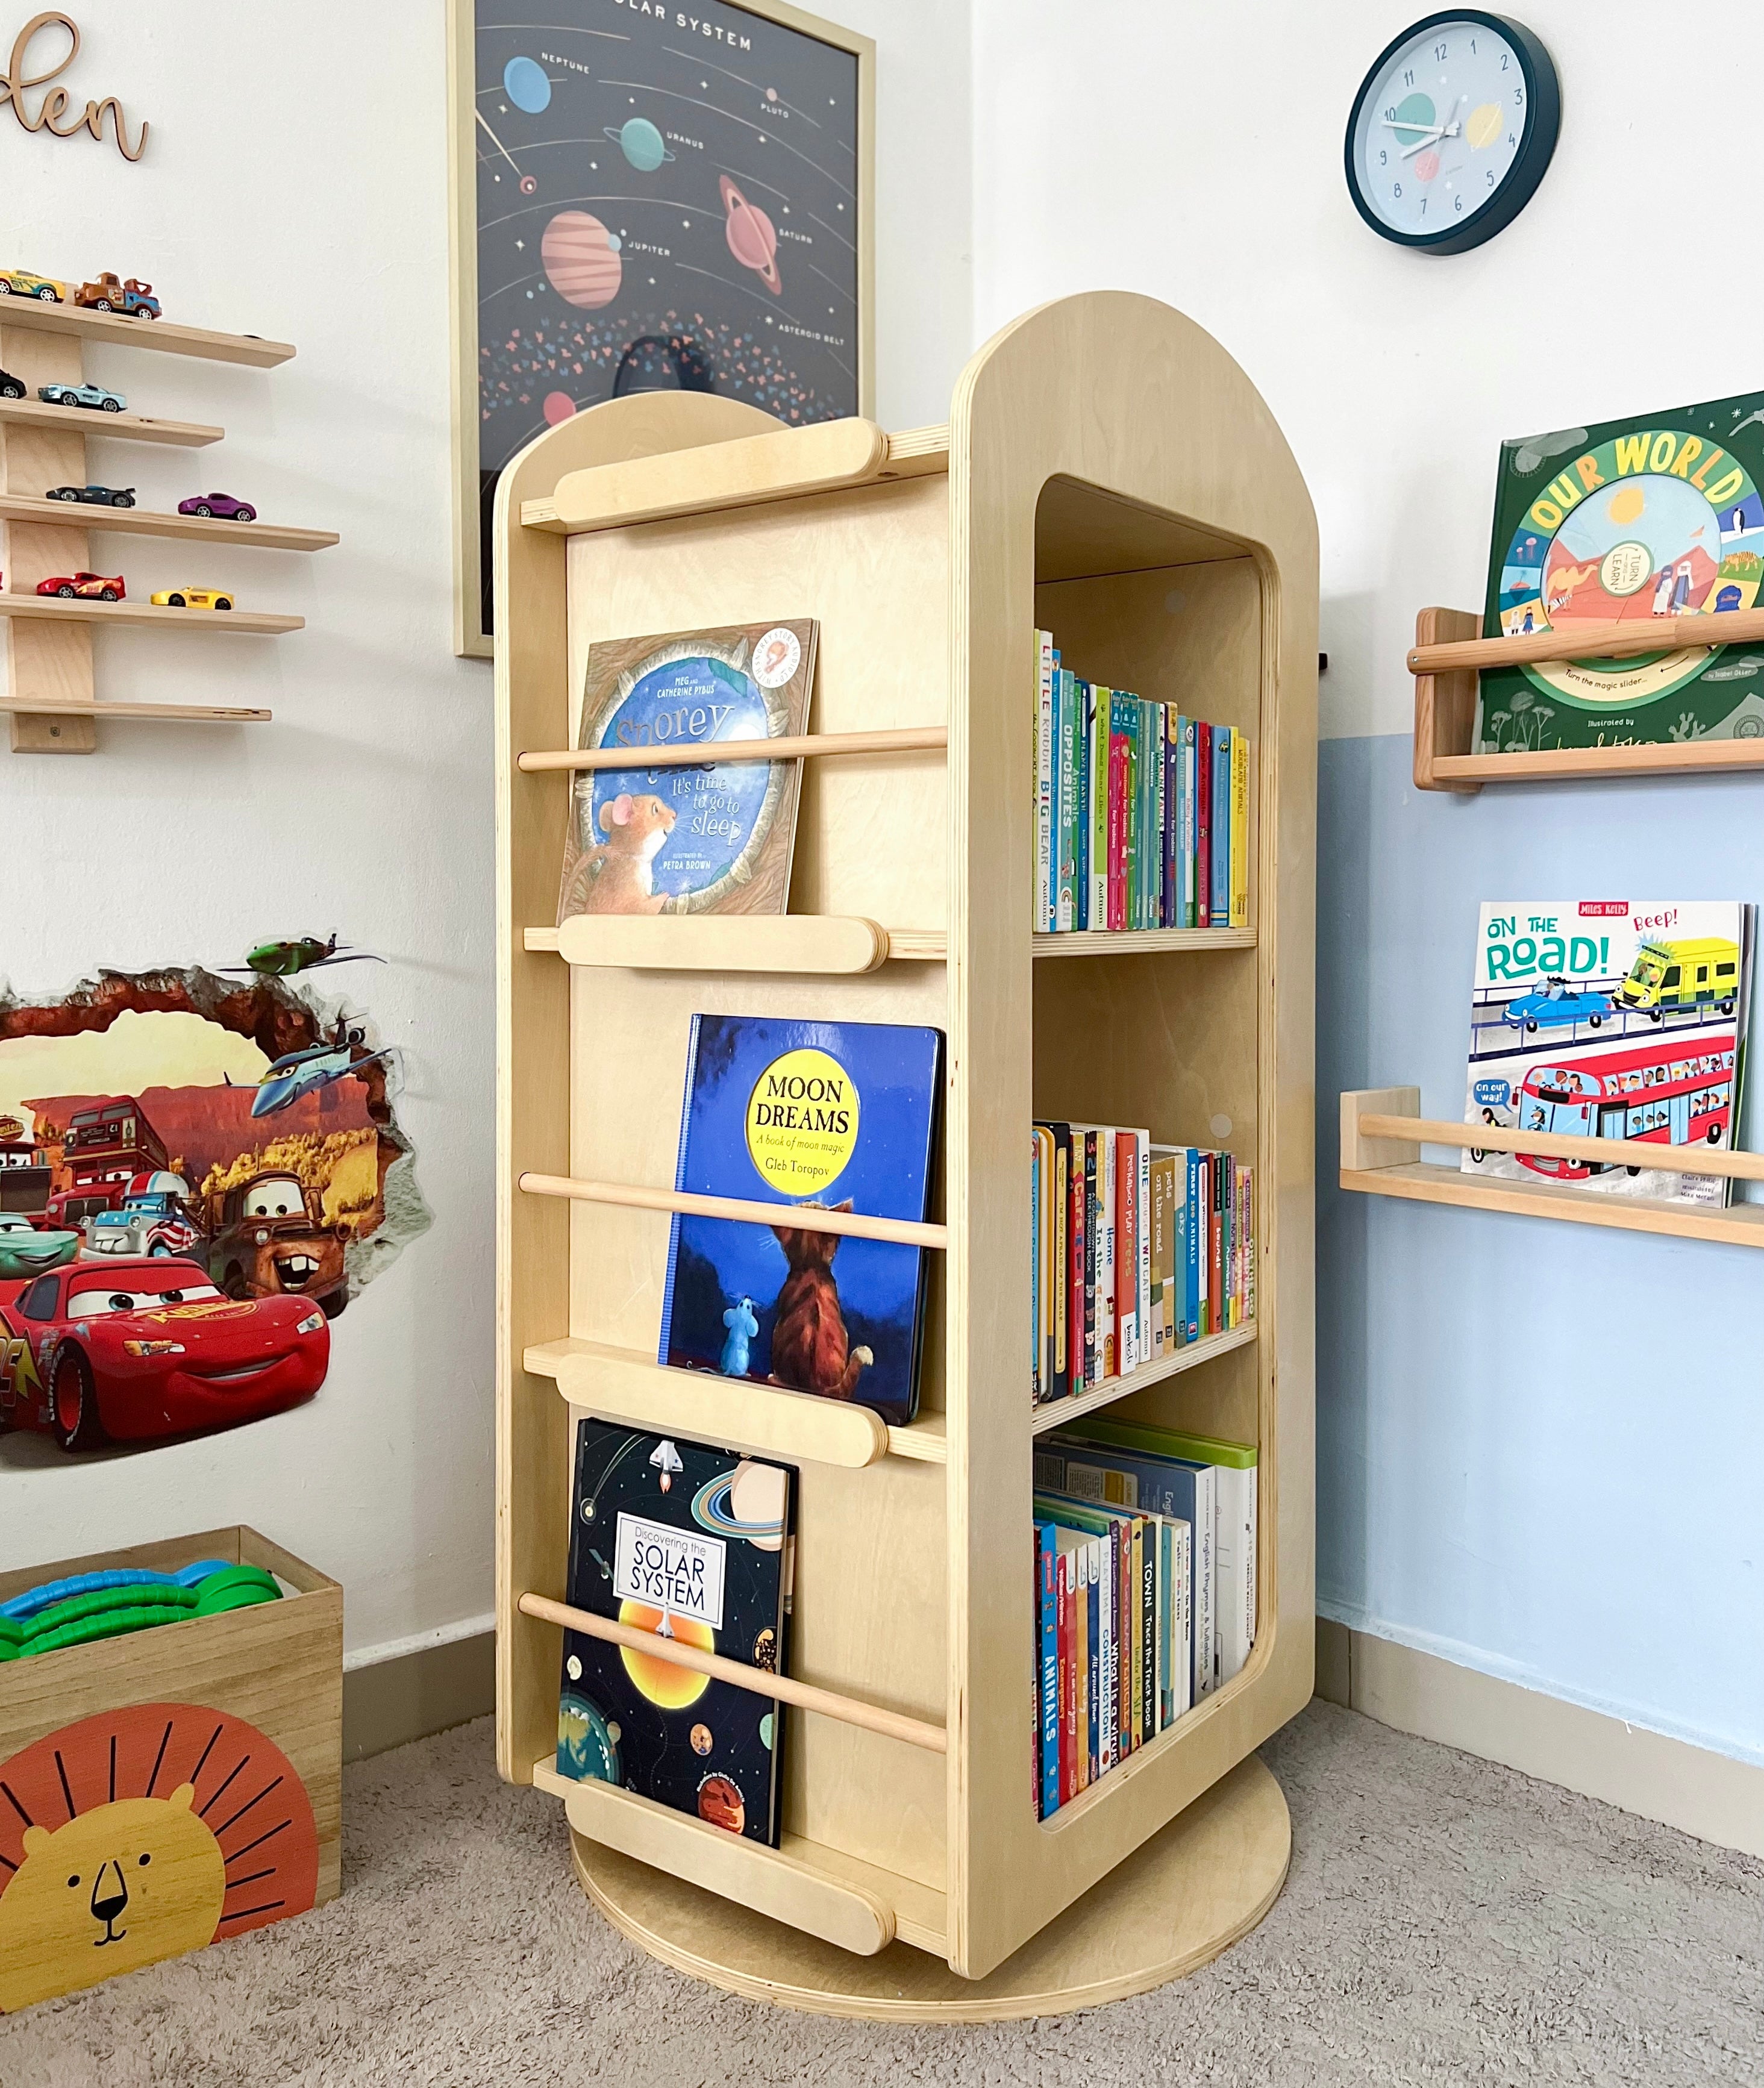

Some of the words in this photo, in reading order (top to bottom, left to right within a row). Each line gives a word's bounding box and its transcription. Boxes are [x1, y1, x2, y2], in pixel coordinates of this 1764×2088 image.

[614, 0, 666, 19] LAR
[676, 13, 751, 51] SYSTEM
[1434, 44, 1447, 61] 12
[1471, 39, 1476, 54] 1
[542, 52, 590, 75] NEPTUNE
[1500, 54, 1509, 71] 2
[1404, 70, 1415, 87] 11
[1514, 89, 1522, 105] 3
[760, 102, 789, 119] PLUTO
[1384, 107, 1396, 122] 10
[666, 131, 704, 149] URANUS
[1509, 133, 1516, 148] 4
[1380, 151, 1387, 166] 9
[1486, 170, 1494, 187] 5
[1394, 183, 1402, 198] 8
[1420, 198, 1427, 214] 7
[1455, 195, 1462, 211] 6
[779, 228, 812, 244] SATURN
[628, 240, 671, 257] JUPITER
[779, 324, 821, 340] ASTEROID
[824, 335, 844, 346] BELT
[1531, 455, 1604, 528] OUR
[1615, 433, 1743, 504] WORLD
[1610, 554, 1622, 586] LEARN
[1629, 555, 1641, 581] TURN
[675, 676, 689, 686] MEG
[1042, 645, 1051, 711] LITTLE
[1565, 669, 1580, 681] Turn
[1582, 677, 1594, 686] the
[1595, 681, 1617, 691] magic
[657, 687, 692, 699] CATHERINE
[694, 685, 715, 695] PYBUS
[617, 705, 734, 747] Snorey
[1625, 718, 1634, 727] by
[1042, 719, 1051, 771] Rabbit
[672, 778, 691, 797] It's
[695, 774, 727, 792] time
[1063, 725, 1072, 828] OPPOSITES
[693, 794, 705, 810] to
[708, 794, 724, 814] go
[727, 796, 739, 813] to
[1040, 781, 1049, 817] BIG
[691, 810, 741, 847] sleep
[663, 861, 683, 870] PETRA
[686, 860, 711, 869] BROWN
[1487, 916, 1516, 938] ON
[1528, 917, 1558, 933] THE
[767, 1075, 843, 1103] MOON
[1481, 1092, 1503, 1103] way!
[755, 1103, 849, 1134] DREAMS
[756, 1134, 763, 1143] A
[766, 1134, 784, 1146] book
[786, 1136, 796, 1151] of
[797, 1141, 819, 1150] moon
[821, 1142, 845, 1155] magic
[1087, 1141, 1096, 1153] 3
[766, 1157, 787, 1171] Gleb
[790, 1160, 829, 1179] Toropov
[1087, 1157, 1096, 1171] 2
[1156, 1174, 1163, 1192] on
[1074, 1181, 1084, 1229] Cars
[1096, 1228, 1102, 1245] In
[1249, 1239, 1254, 1259] ON
[1249, 1293, 1254, 1314] GO
[635, 1527, 688, 1553] Discovering
[691, 1542, 707, 1557] the
[634, 1540, 704, 1584] SOLAR
[630, 1566, 704, 1610] SYSTEM
[1144, 1560, 1153, 1608] TOWN
[1111, 1641, 1119, 1683] What
[1044, 1656, 1057, 1742] ANIMALS
[1111, 1686, 1119, 1701] is
[1110, 1705, 1118, 1718] a
[1110, 1723, 1119, 1766] virus?
